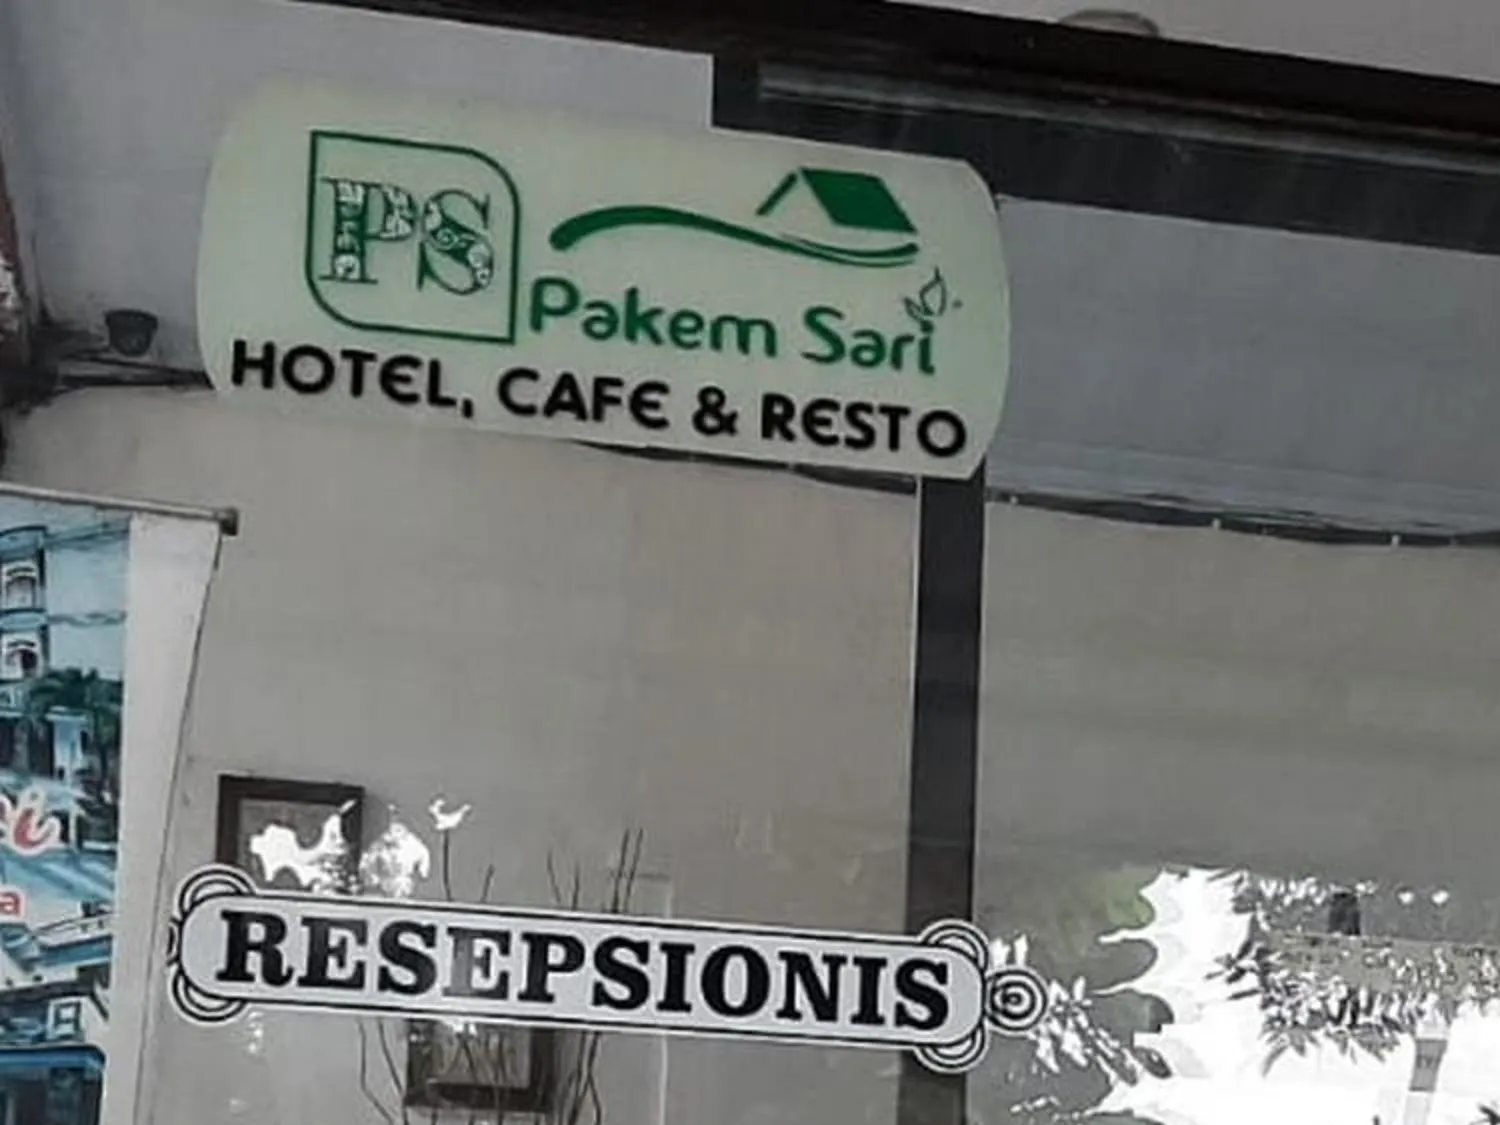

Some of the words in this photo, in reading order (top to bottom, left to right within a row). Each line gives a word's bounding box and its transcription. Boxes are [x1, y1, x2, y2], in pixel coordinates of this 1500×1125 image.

[318, 176, 494, 296] PS
[530, 277, 778, 359] Pakem
[801, 305, 938, 375] Sari
[231, 339, 473, 419] HOTEL,
[498, 367, 671, 429] CAFE
[694, 387, 738, 436] &
[761, 394, 967, 459] RESTO
[216, 910, 952, 1030] RESEPSIONIS
